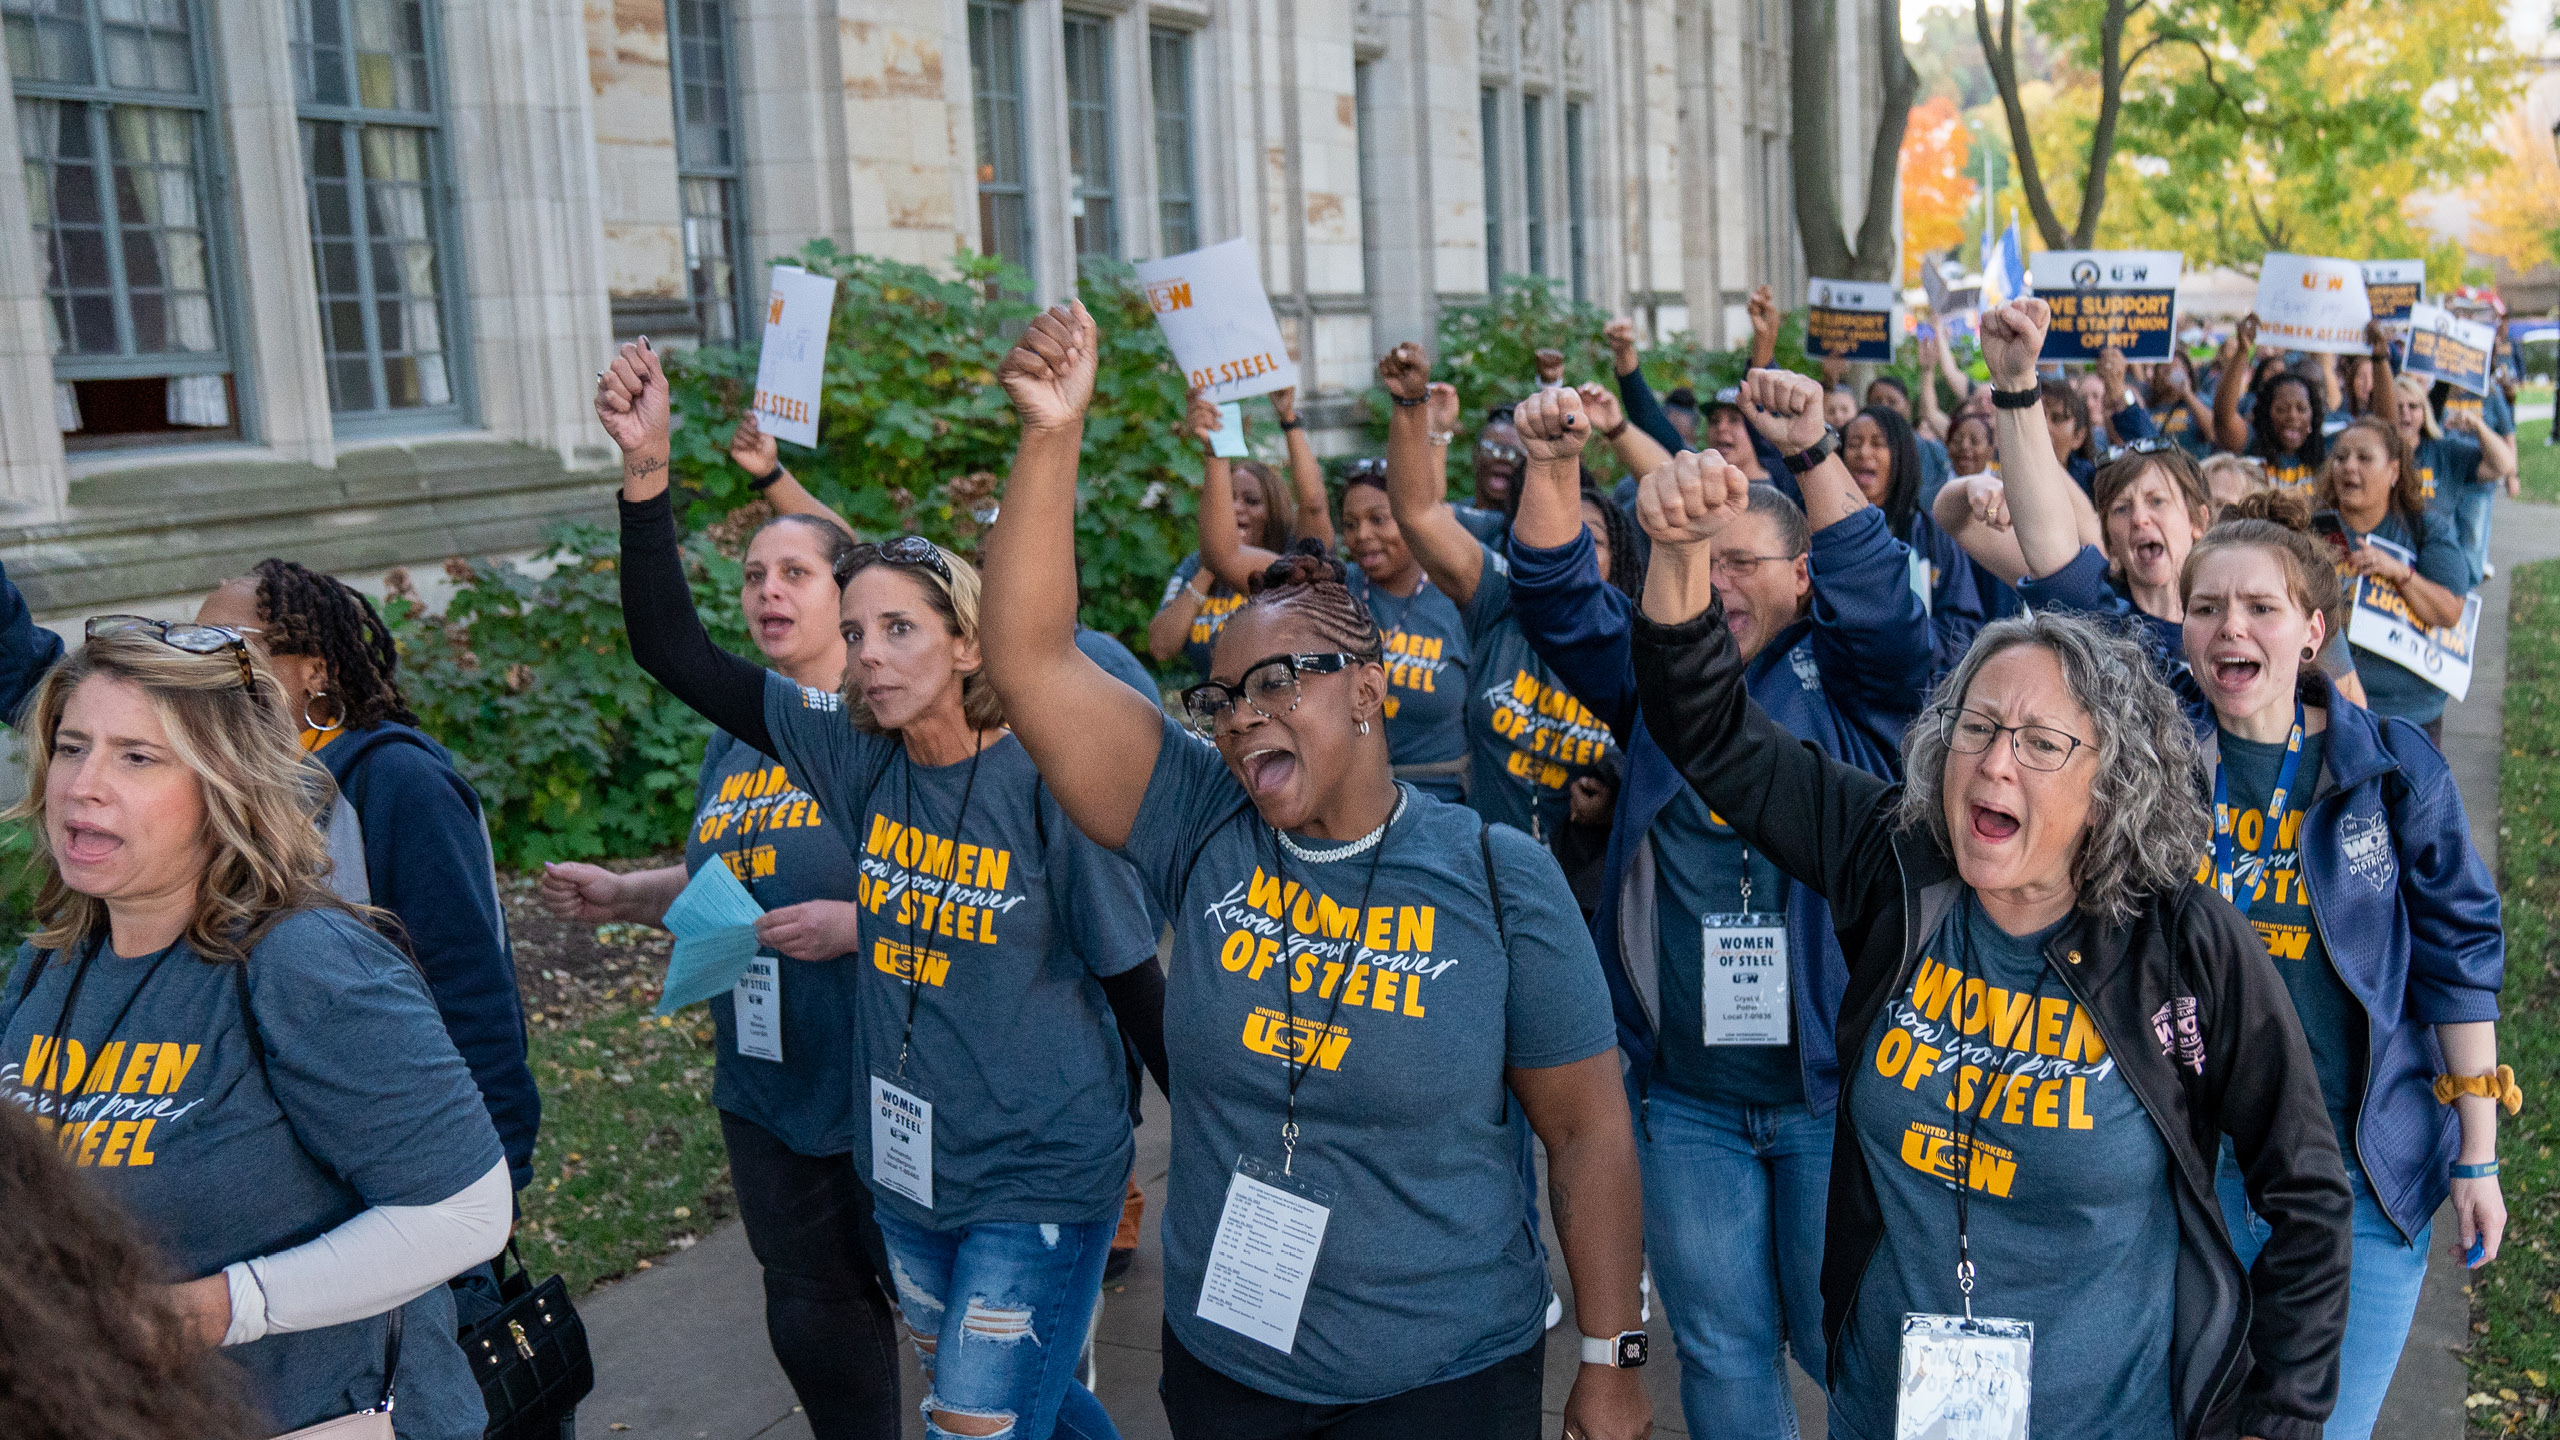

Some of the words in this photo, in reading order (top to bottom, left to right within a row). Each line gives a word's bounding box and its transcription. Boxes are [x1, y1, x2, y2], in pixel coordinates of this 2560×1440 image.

[2043, 296, 2077, 315] WE
[2082, 295, 2169, 315] SUPPORT
[2050, 317, 2073, 332] HE
[2127, 316, 2169, 331] UNION
[2260, 322, 2313, 339] WOMEN
[1193, 368, 1215, 390] OF
[1220, 353, 1278, 383] STEEL
[770, 394, 809, 424] STEEL
[1492, 706, 1529, 740] OF
[699, 813, 733, 844] OF
[737, 800, 821, 836] STEEL
[867, 813, 1011, 891] WOMEN
[2349, 848, 2389, 876] DISTRICT
[859, 872, 890, 915] OF
[896, 889, 998, 945] STEEL
[939, 881, 1026, 914] power
[1247, 865, 1435, 952] WOMEN
[1205, 881, 1283, 934] Know
[1344, 945, 1458, 984] power
[1720, 936, 1774, 950] WOMEN
[747, 963, 770, 977] OMEN
[873, 942, 952, 988] USW
[1221, 929, 1280, 981] OF
[1290, 953, 1426, 1018] STEEL
[1719, 955, 1735, 968] OF
[1738, 955, 1775, 967] STEEL
[1254, 1005, 1286, 1021] UNITED
[1912, 956, 2107, 1064] WOMEN
[1242, 1012, 1352, 1071] USW
[22, 1034, 202, 1096] WOMEN
[1875, 1027, 1942, 1091] OF
[1945, 1065, 2094, 1130] STEEL
[881, 1088, 922, 1119] WOMEN
[881, 1106, 893, 1120] OF
[895, 1112, 922, 1135] STEEL
[1911, 1121, 1948, 1139] UNITED
[1901, 1129, 2018, 1198] USW
